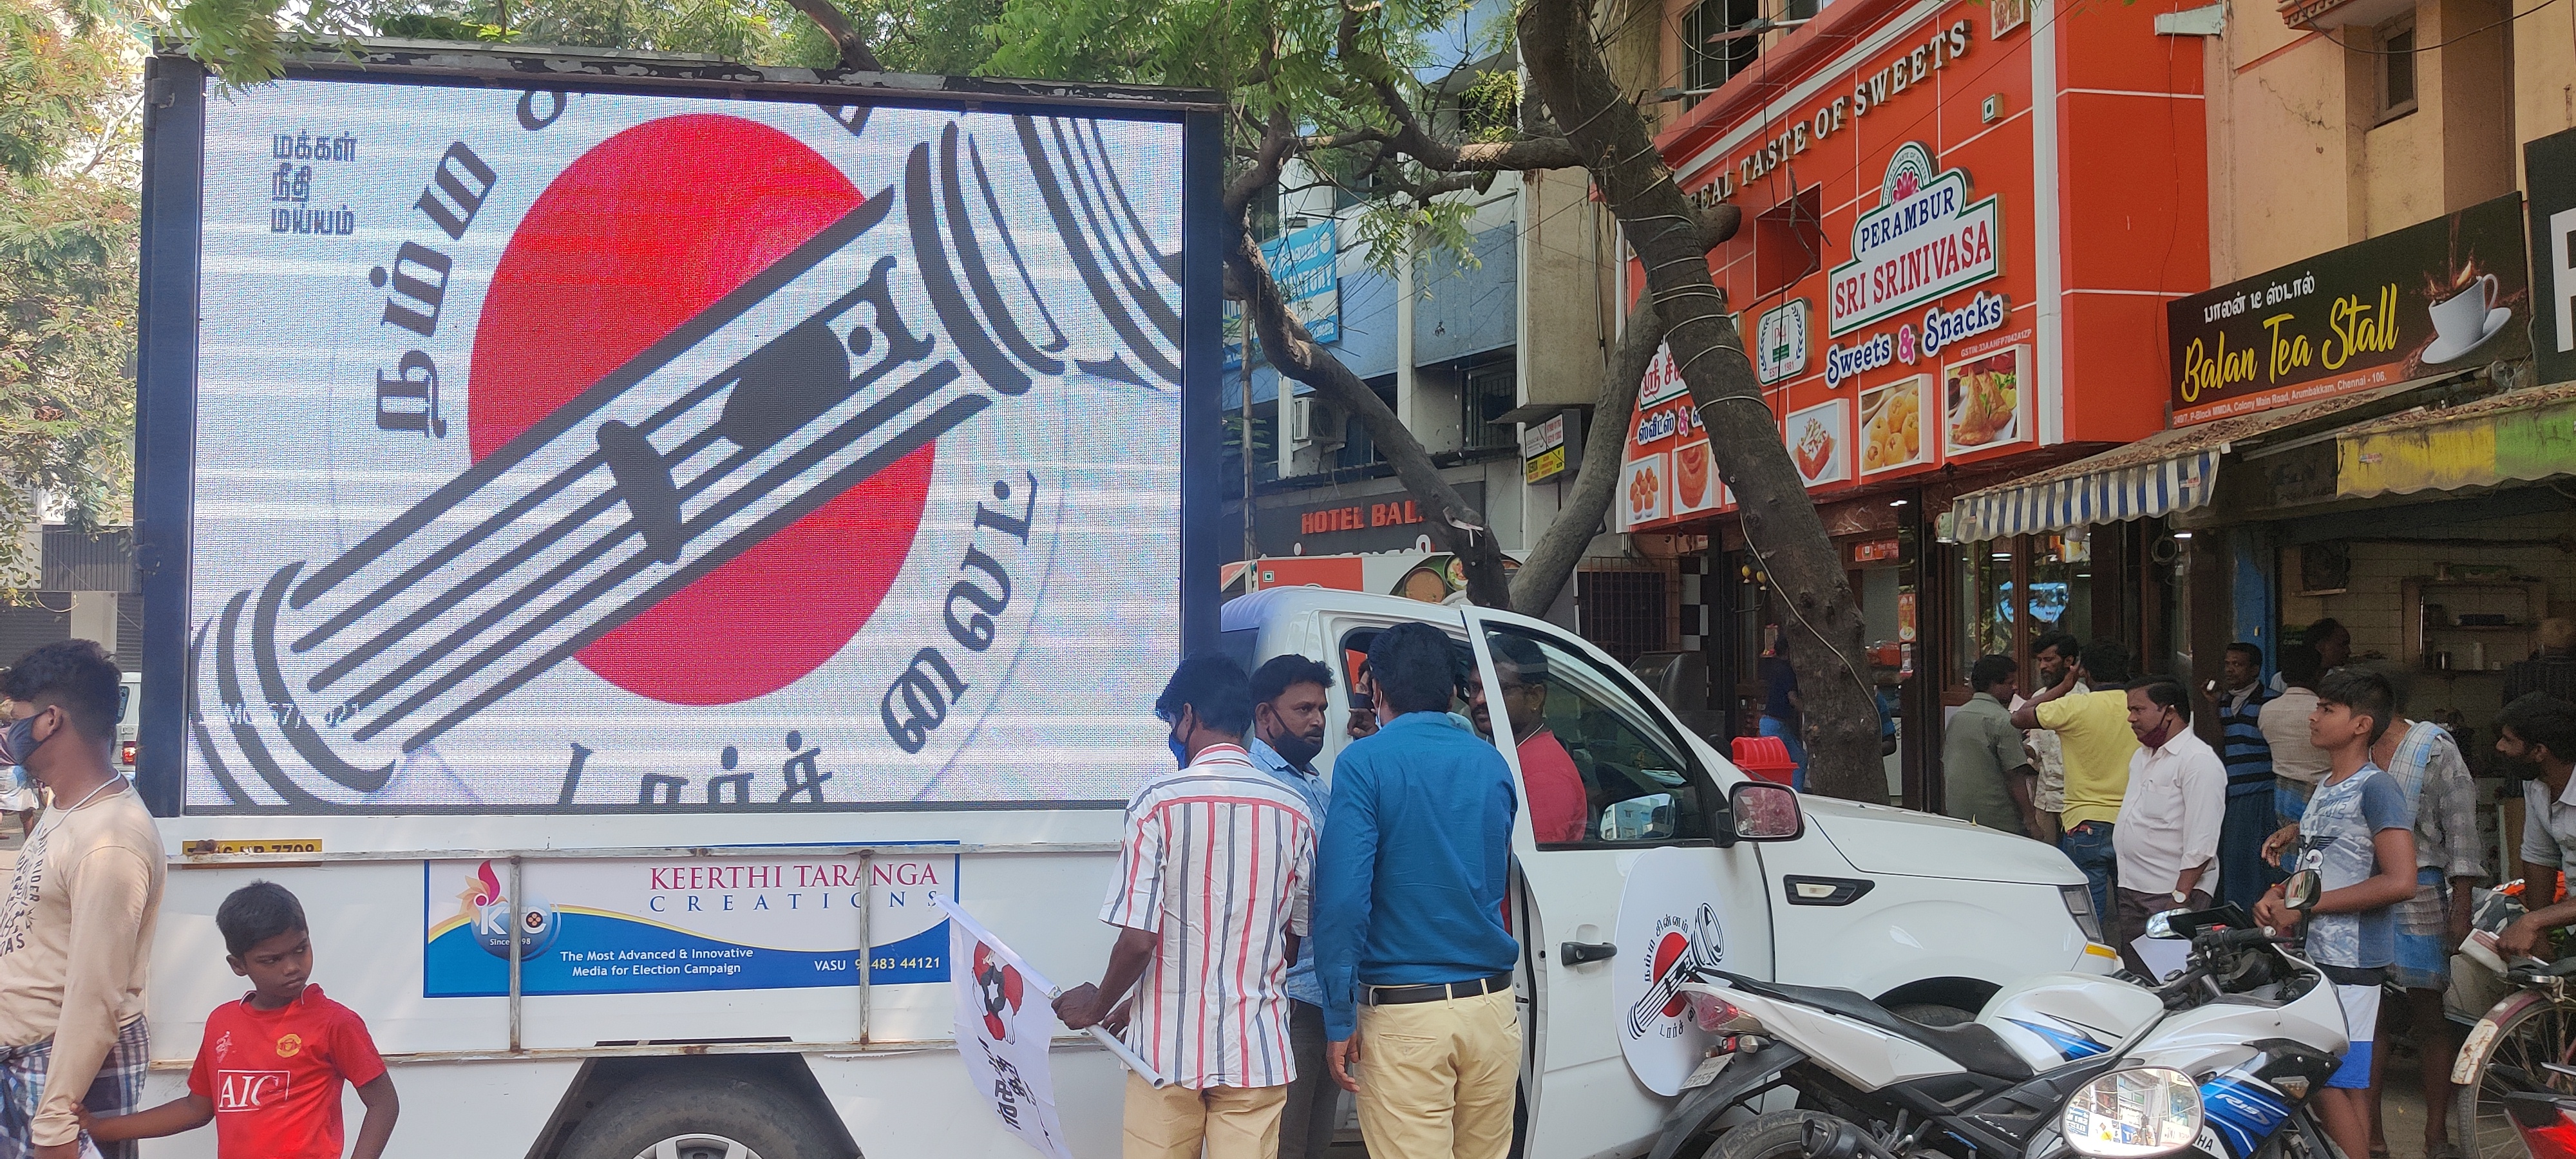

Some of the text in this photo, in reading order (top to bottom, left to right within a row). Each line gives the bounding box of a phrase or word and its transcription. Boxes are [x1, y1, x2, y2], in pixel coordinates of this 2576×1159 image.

[1740, 120, 1806, 186] TASTE
[1814, 95, 1844, 140] OF
[1854, 19, 1965, 118] SWEETS
[273, 129, 357, 161] மக்கள்
[272, 162, 312, 202] நீதி
[271, 204, 354, 235] மய்யம்
[1861, 186, 1955, 252] PERAMBUR
[1835, 220, 1991, 319] SRI SRINIVASA
[369, 140, 498, 439] நம்ம
[2204, 270, 2315, 324] பாலன் டீ ஸ்டால்
[1828, 296, 2001, 384] Sweets & Snacks
[2181, 283, 2400, 402] Balan Tea Stall
[2234, 400, 2255, 412] Colony
[2256, 397, 2271, 407] Main
[1302, 500, 1423, 534] HOTEL BAL
[29, 858, 44, 902] RIDER
[649, 863, 940, 890] KEERTHI TARANGA
[489, 938, 510, 946] Since
[1656, 913, 1689, 938] சின்னம்
[560, 948, 753, 962] The Most Advanced & Innovative
[573, 963, 741, 977] Media for Election Campaign
[814, 960, 846, 972] VASU
[900, 957, 940, 969] 44121
